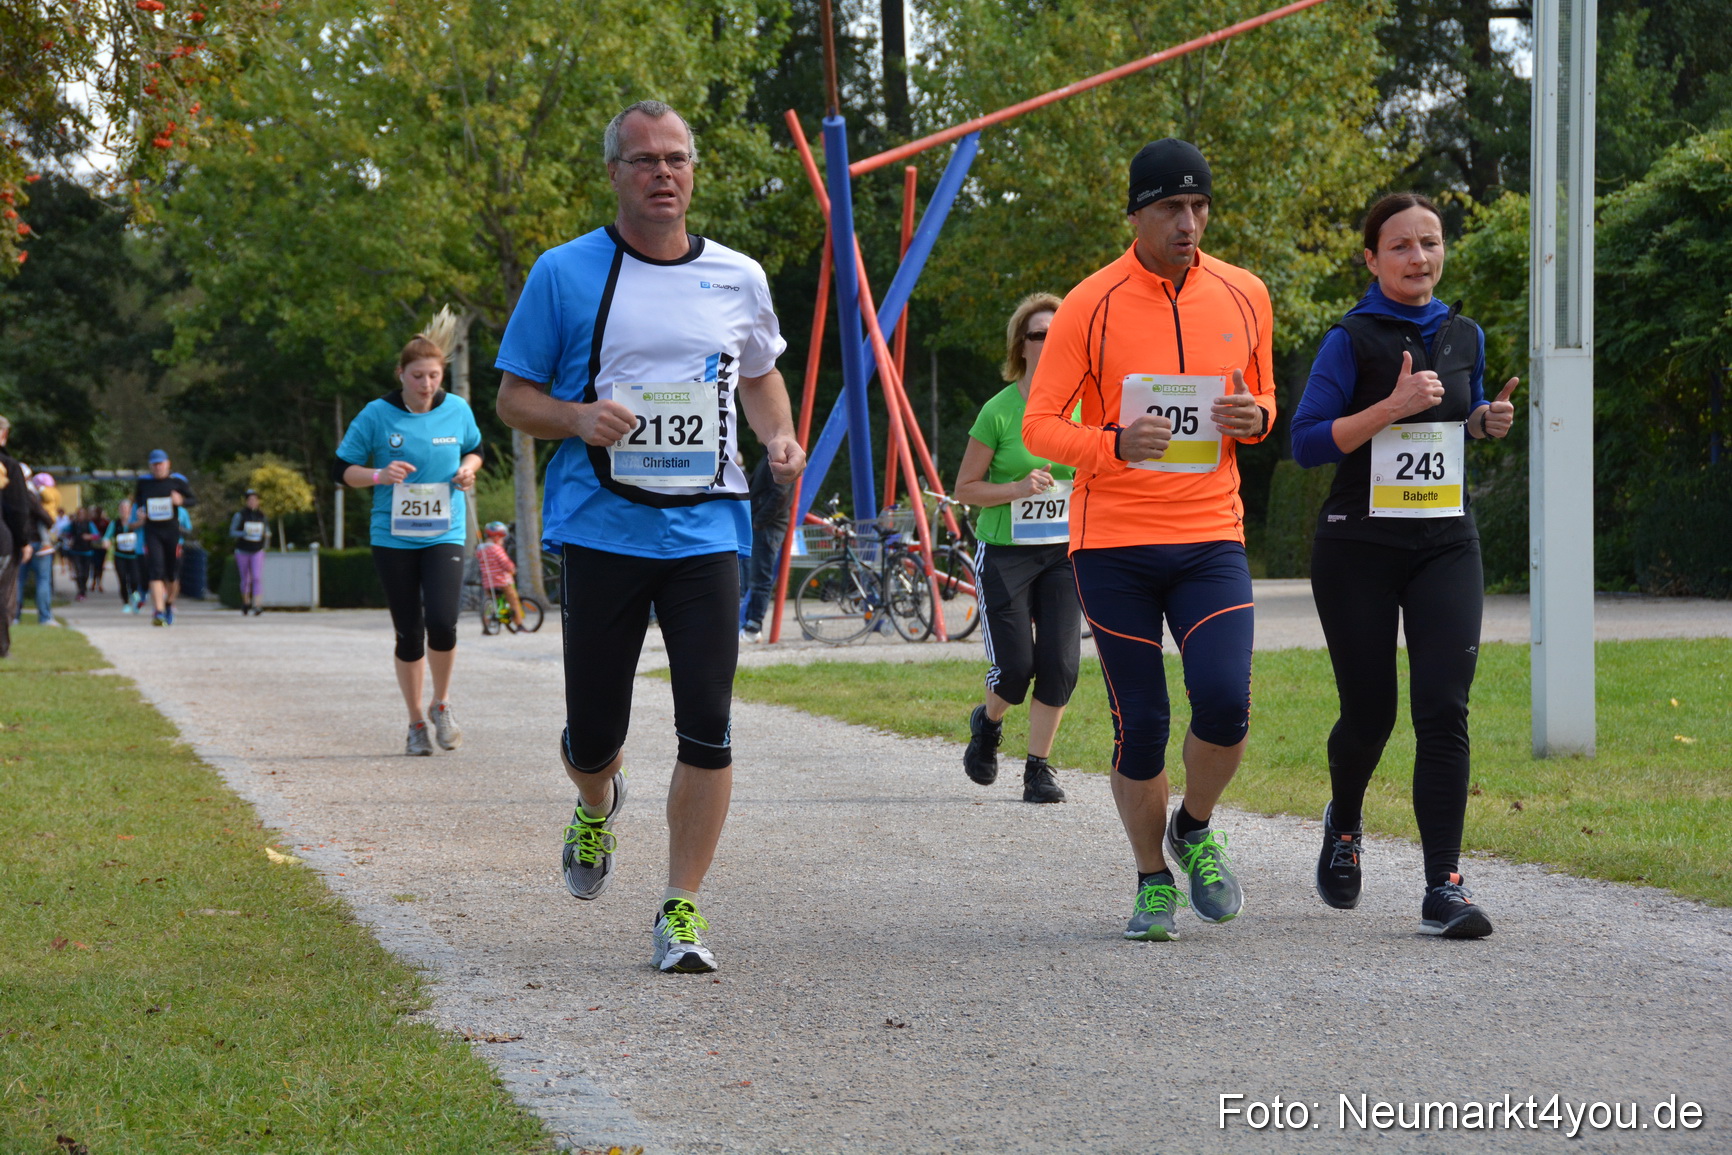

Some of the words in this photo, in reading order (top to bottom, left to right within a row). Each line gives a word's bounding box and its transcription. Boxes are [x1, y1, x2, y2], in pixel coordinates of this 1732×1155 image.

[1162, 384, 1197, 393] BOCK
[654, 392, 690, 401] BOCK
[628, 414, 704, 446] 2132
[1412, 432, 1442, 440] BOCK
[642, 456, 690, 468] Christian
[1396, 452, 1445, 481] 243
[1403, 490, 1438, 501] Babette
[401, 500, 442, 516] 2514
[1022, 498, 1066, 520] 2797
